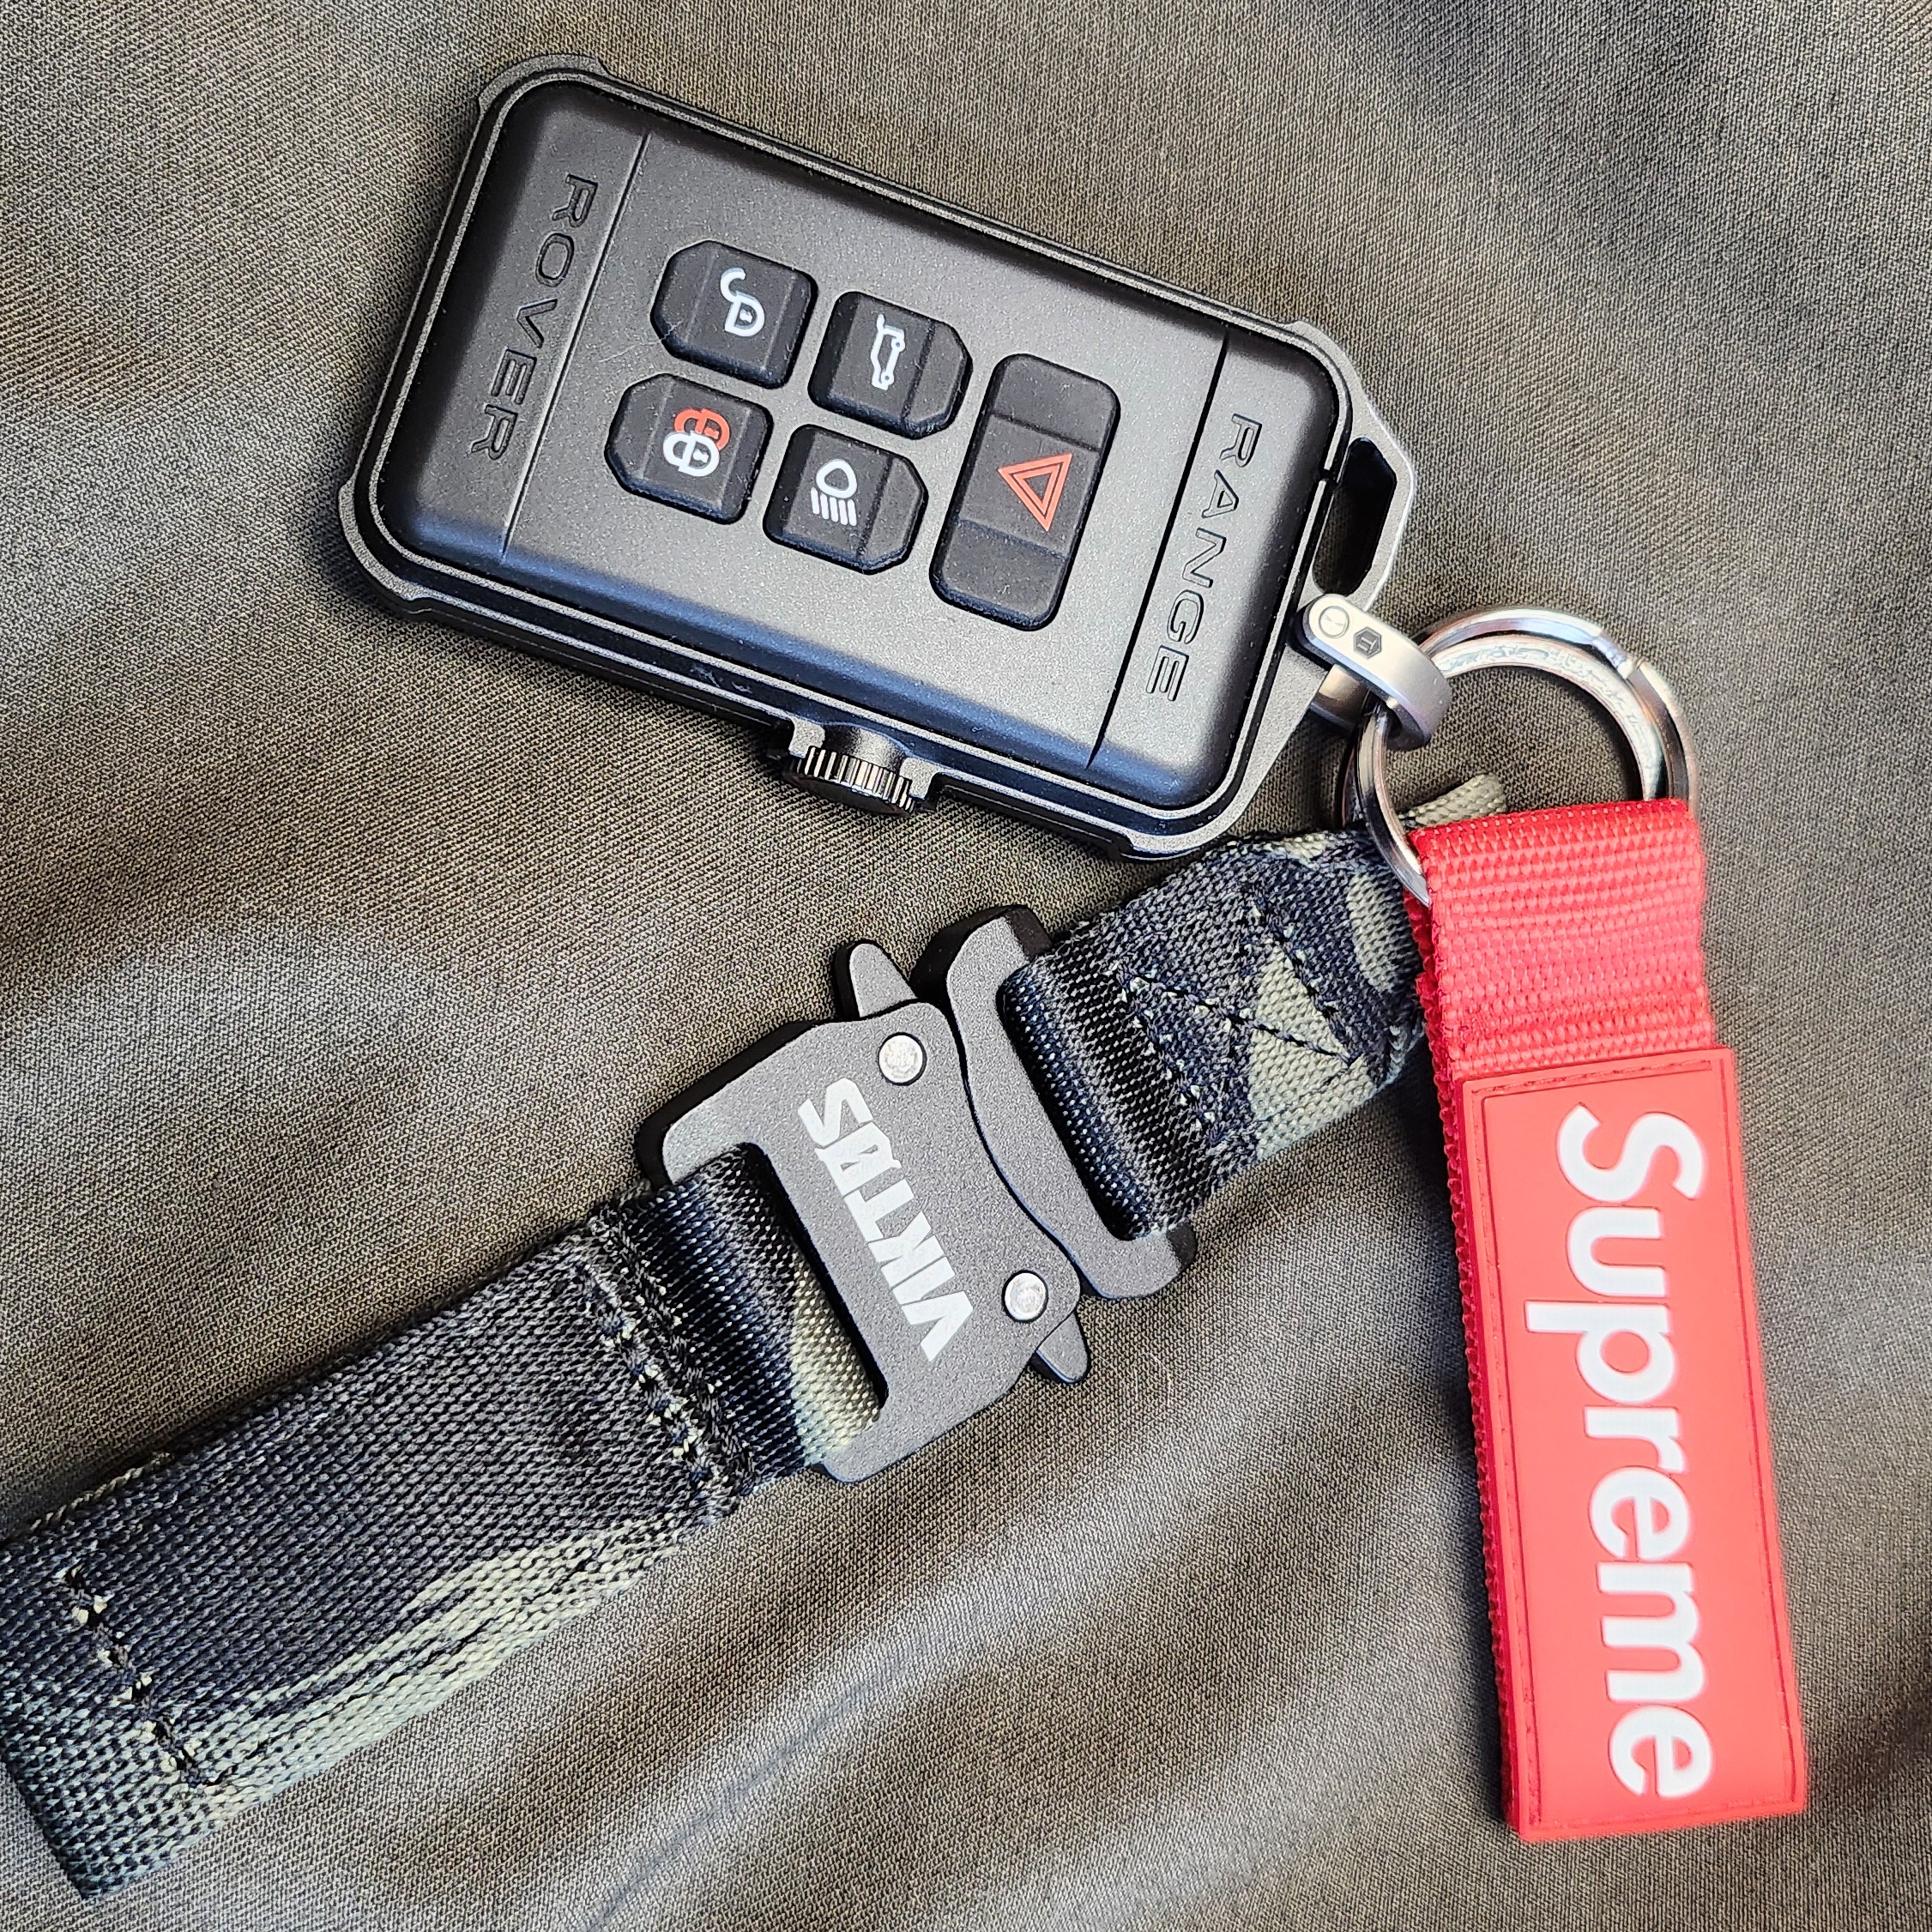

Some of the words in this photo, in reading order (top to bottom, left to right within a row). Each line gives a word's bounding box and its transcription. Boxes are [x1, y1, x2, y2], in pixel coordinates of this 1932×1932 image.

[470, 174, 598, 461] ROVER
[1145, 413, 1262, 702] RANGE
[1524, 1103, 1713, 1798] Supreme
